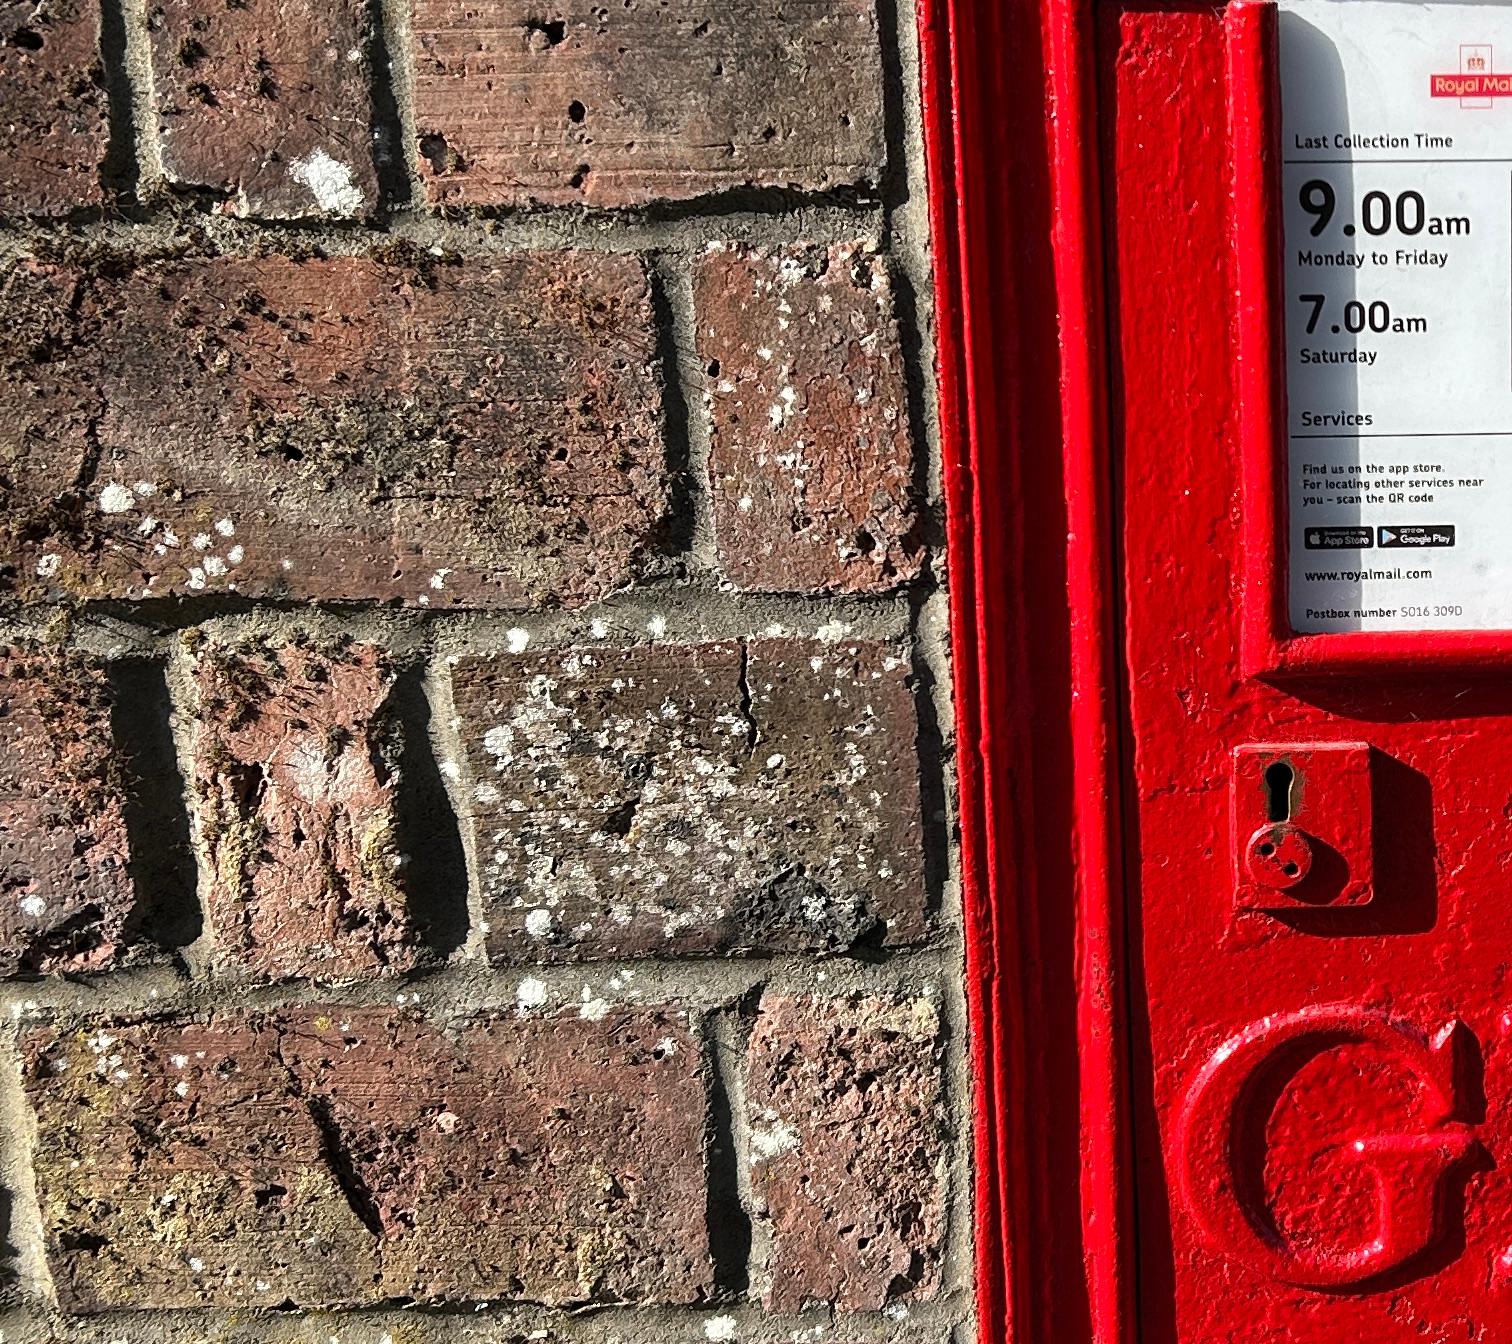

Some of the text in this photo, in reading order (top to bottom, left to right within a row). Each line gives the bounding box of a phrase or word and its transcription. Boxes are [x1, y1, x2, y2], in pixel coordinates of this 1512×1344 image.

[1435, 77, 1479, 95] Royal
[1295, 133, 1453, 149] Last Collection Time
[1299, 179, 1470, 237] 9.00am
[1298, 249, 1448, 269] Monday to Friday
[1298, 294, 1427, 334] 7.00am
[1300, 348, 1377, 366] Saturday
[1301, 410, 1373, 426] Services
[1303, 463, 1445, 475] Find us on the app store.
[1303, 478, 1484, 490] For locating other services near
[1303, 496, 1323, 507] you
[1337, 495, 1362, 504] scan
[1366, 494, 1385, 504] the
[1388, 494, 1404, 503] QR
[1408, 493, 1434, 503] code
[1324, 536, 1370, 546] App Store
[1400, 533, 1450, 545] Google Play
[1305, 568, 1432, 582] www.royalmail.com
[1306, 608, 1350, 619] Postbox
[1354, 608, 1397, 618] number
